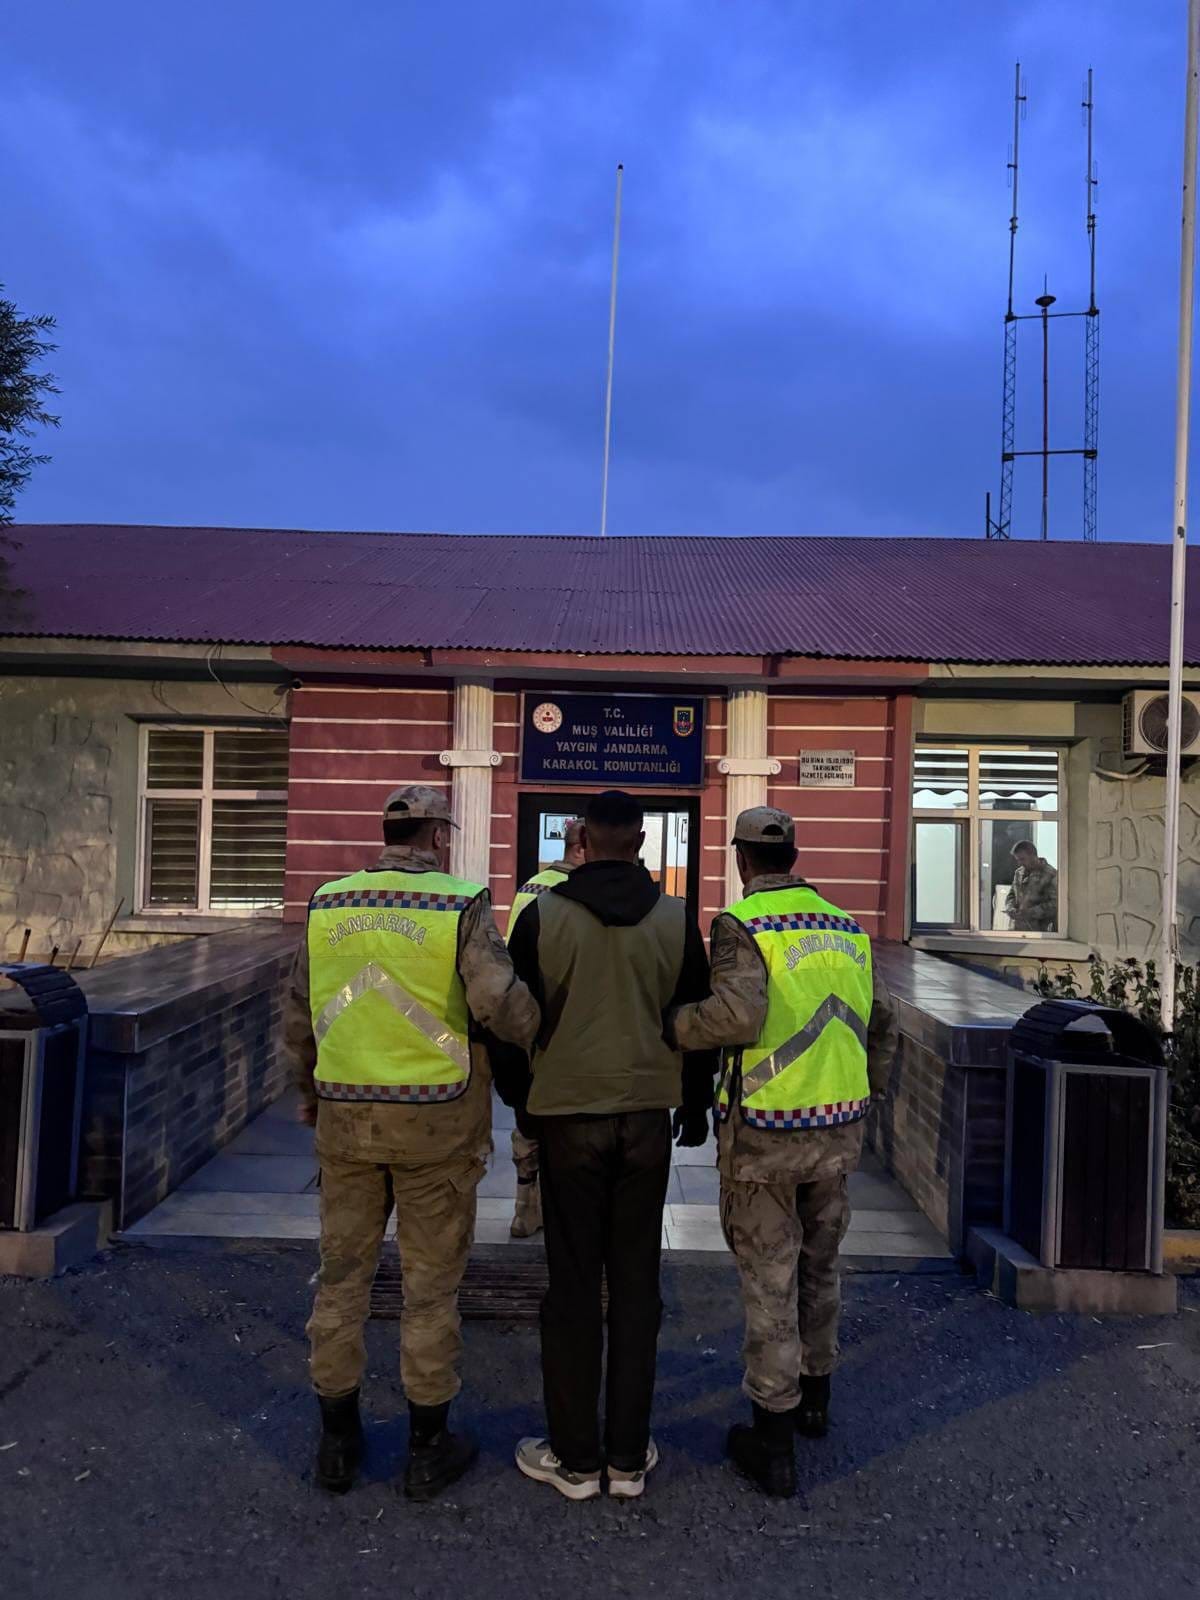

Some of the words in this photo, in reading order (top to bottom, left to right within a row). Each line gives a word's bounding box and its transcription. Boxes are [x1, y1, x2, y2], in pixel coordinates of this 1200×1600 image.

[603, 707, 625, 719] T.C.
[572, 725, 599, 738] MUŞ
[604, 724, 653, 737] VALİLİĞİ
[556, 741, 598, 753] YAYGIN
[603, 743, 668, 755] JANDARMA
[543, 758, 599, 770] KARAKOL
[603, 760, 681, 773] KOMUTANLIĞI
[328, 912, 428, 946] JANDARMA
[783, 933, 867, 971] JANDARMA
